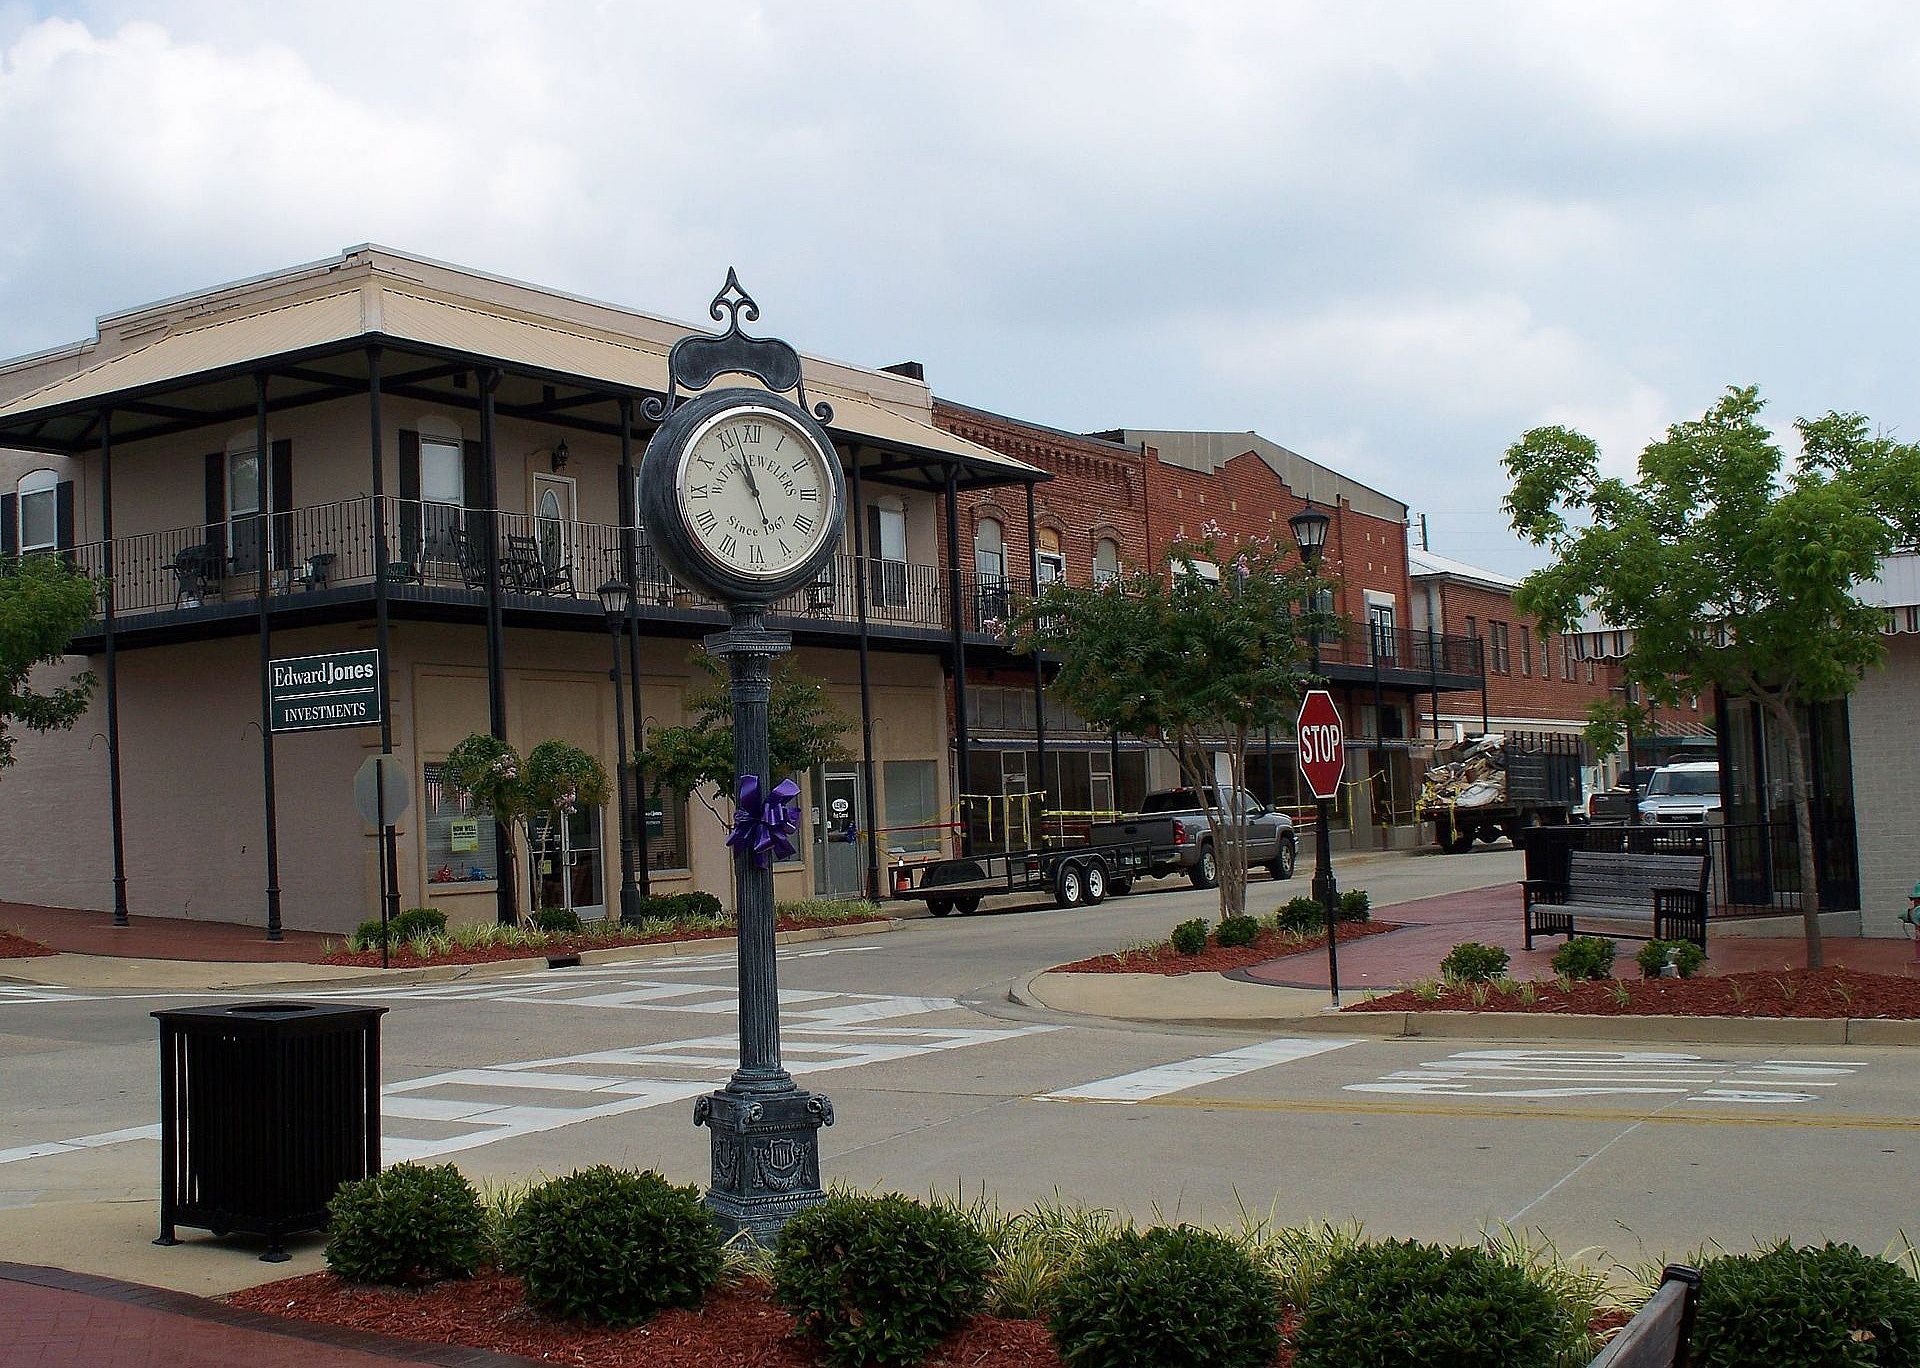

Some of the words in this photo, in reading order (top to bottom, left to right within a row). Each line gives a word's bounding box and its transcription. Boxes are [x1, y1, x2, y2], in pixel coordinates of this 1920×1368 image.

[716, 429, 734, 452] XI
[743, 425, 761, 443] XII
[697, 456, 715, 471] X
[792, 458, 808, 472] II
[743, 454, 797, 497] EWELERS
[690, 484, 708, 499] IX
[800, 489, 817, 501] III
[696, 509, 718, 537] VIII
[727, 515, 759, 536] Since
[763, 514, 786, 535] 1967
[718, 534, 737, 558] VII
[749, 545, 765, 563] VI
[778, 538, 792, 556] V
[285, 703, 366, 722] INVESTMENTS
[1301, 724, 1340, 764] STOP
